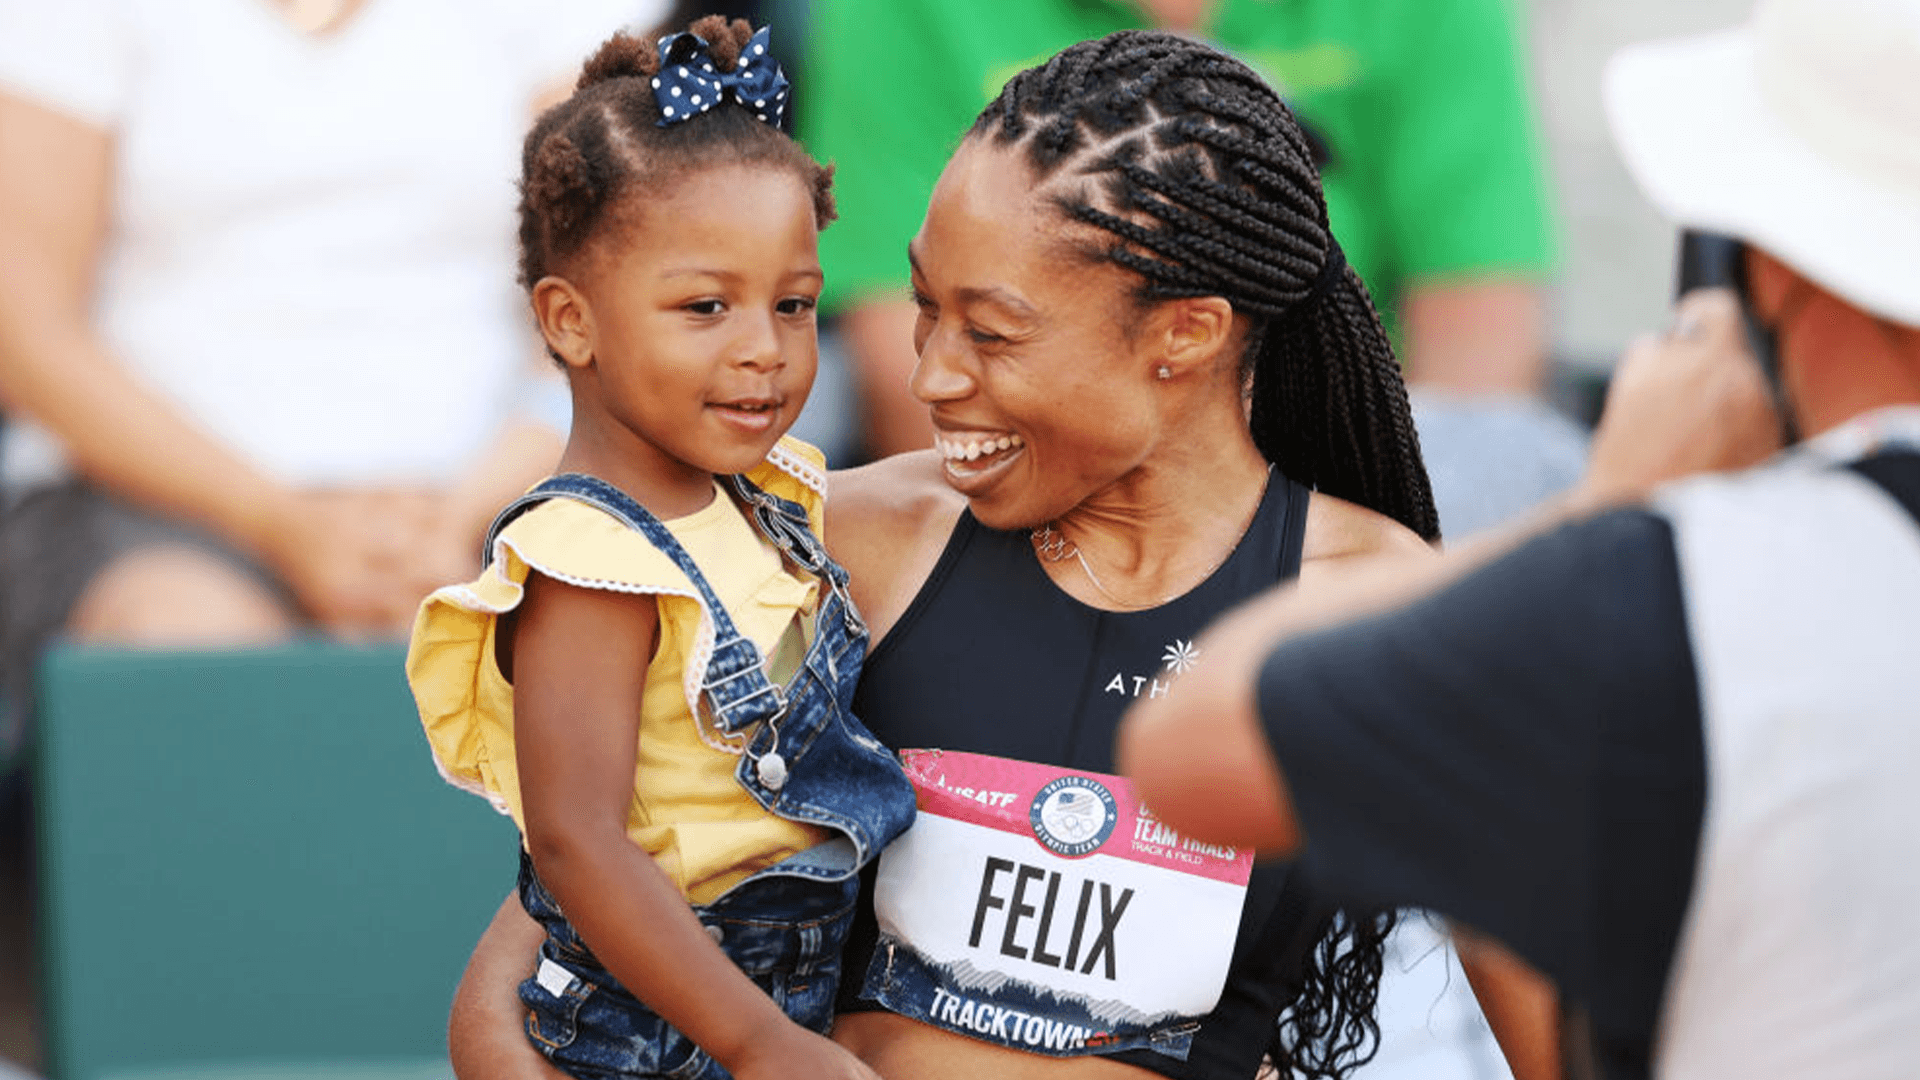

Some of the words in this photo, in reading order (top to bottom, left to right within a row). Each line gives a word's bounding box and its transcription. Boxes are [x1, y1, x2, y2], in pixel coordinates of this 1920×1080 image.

[1075, 837, 1100, 854] TEAM
[1134, 817, 1178, 848] TEAM
[1131, 840, 1163, 855] TRACK
[1174, 852, 1203, 864] FIELD
[968, 856, 1135, 981] FELIX
[930, 987, 1092, 1050] TRACKTOWN
